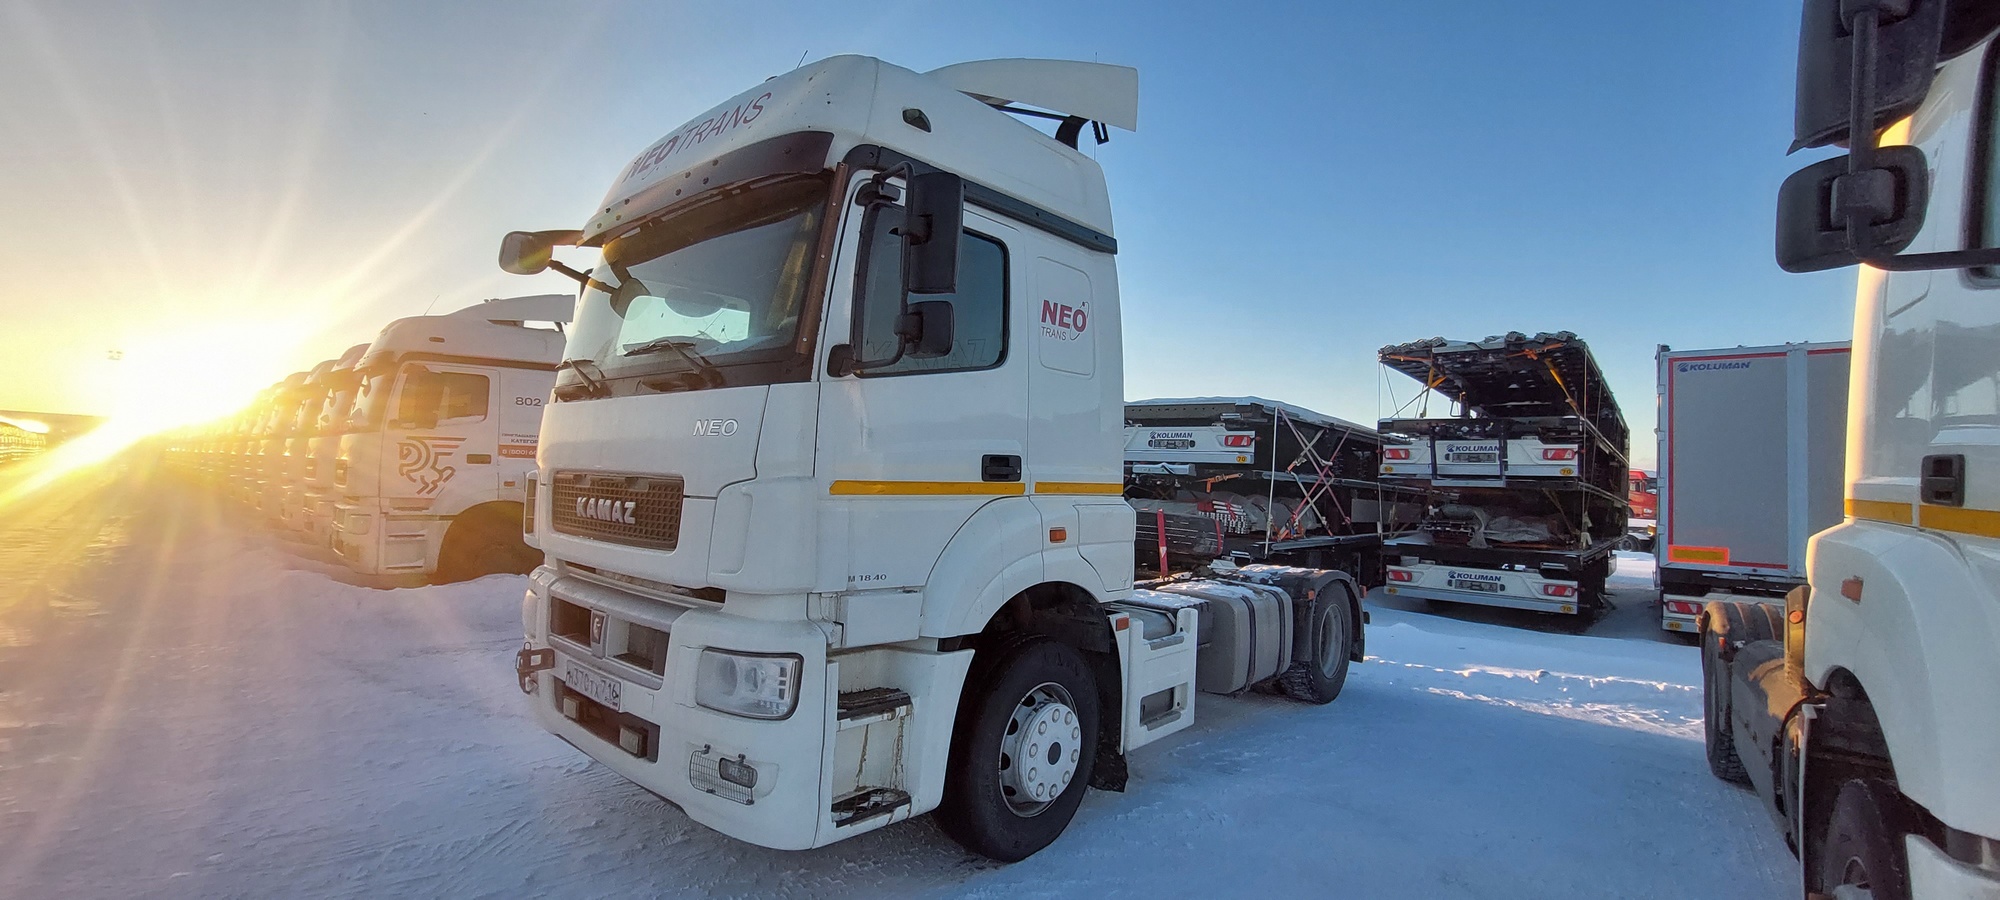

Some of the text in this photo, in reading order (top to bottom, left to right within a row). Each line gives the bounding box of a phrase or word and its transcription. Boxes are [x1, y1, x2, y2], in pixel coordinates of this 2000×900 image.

[622, 92, 772, 183] NEO TRANS
[1041, 299, 1087, 333] NEO
[1041, 326, 1067, 341] TRANS
[1690, 361, 1751, 371] KOLUMAN
[515, 396, 542, 407] 802
[692, 418, 739, 437] NEO
[576, 496, 636, 524] KAMAZ
[1456, 572, 1502, 582] KOLUMAN
